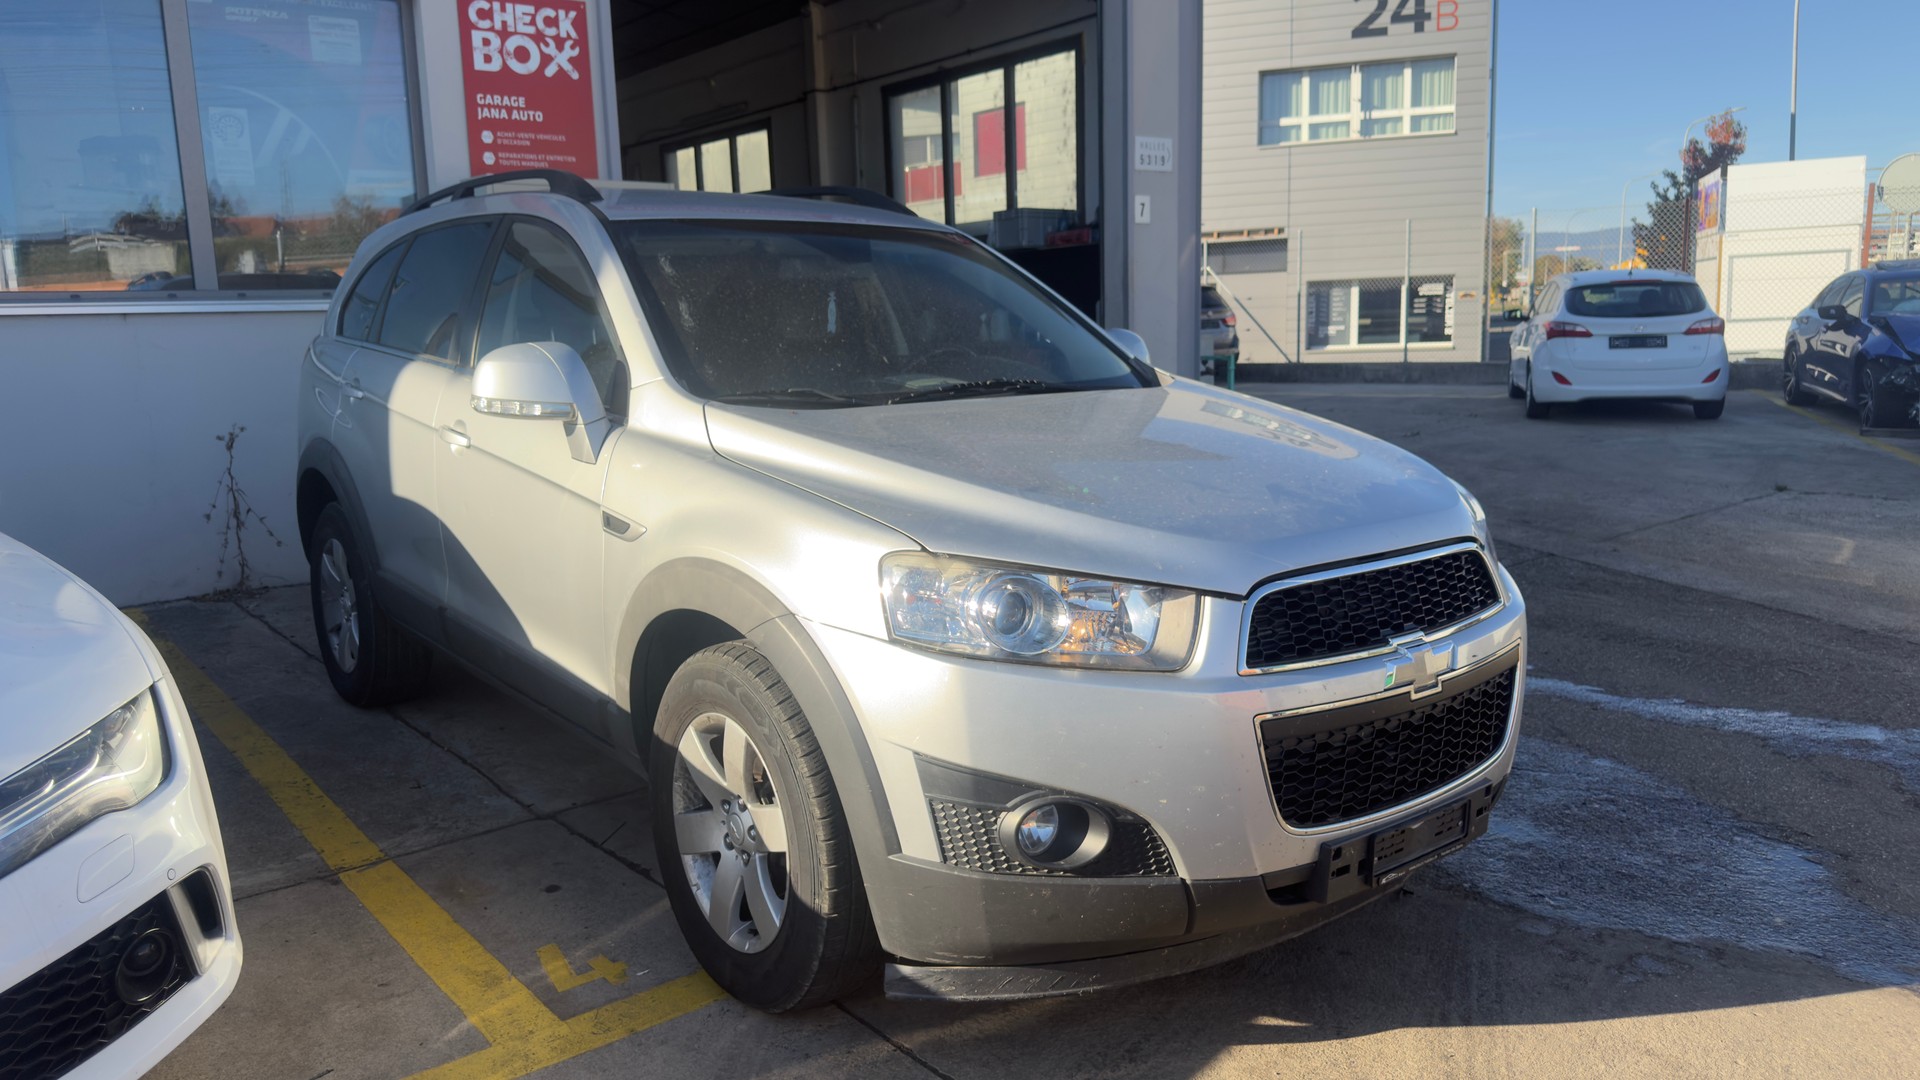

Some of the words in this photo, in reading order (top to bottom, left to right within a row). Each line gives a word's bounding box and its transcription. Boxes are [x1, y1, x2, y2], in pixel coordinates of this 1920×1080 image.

[225, 6, 288, 19] POTENZA
[468, 0, 579, 39] CHECK
[476, 93, 526, 108] GARAGE
[478, 107, 508, 120] JANA
[511, 109, 543, 122] AUTO
[1139, 203, 1145, 217] 7
